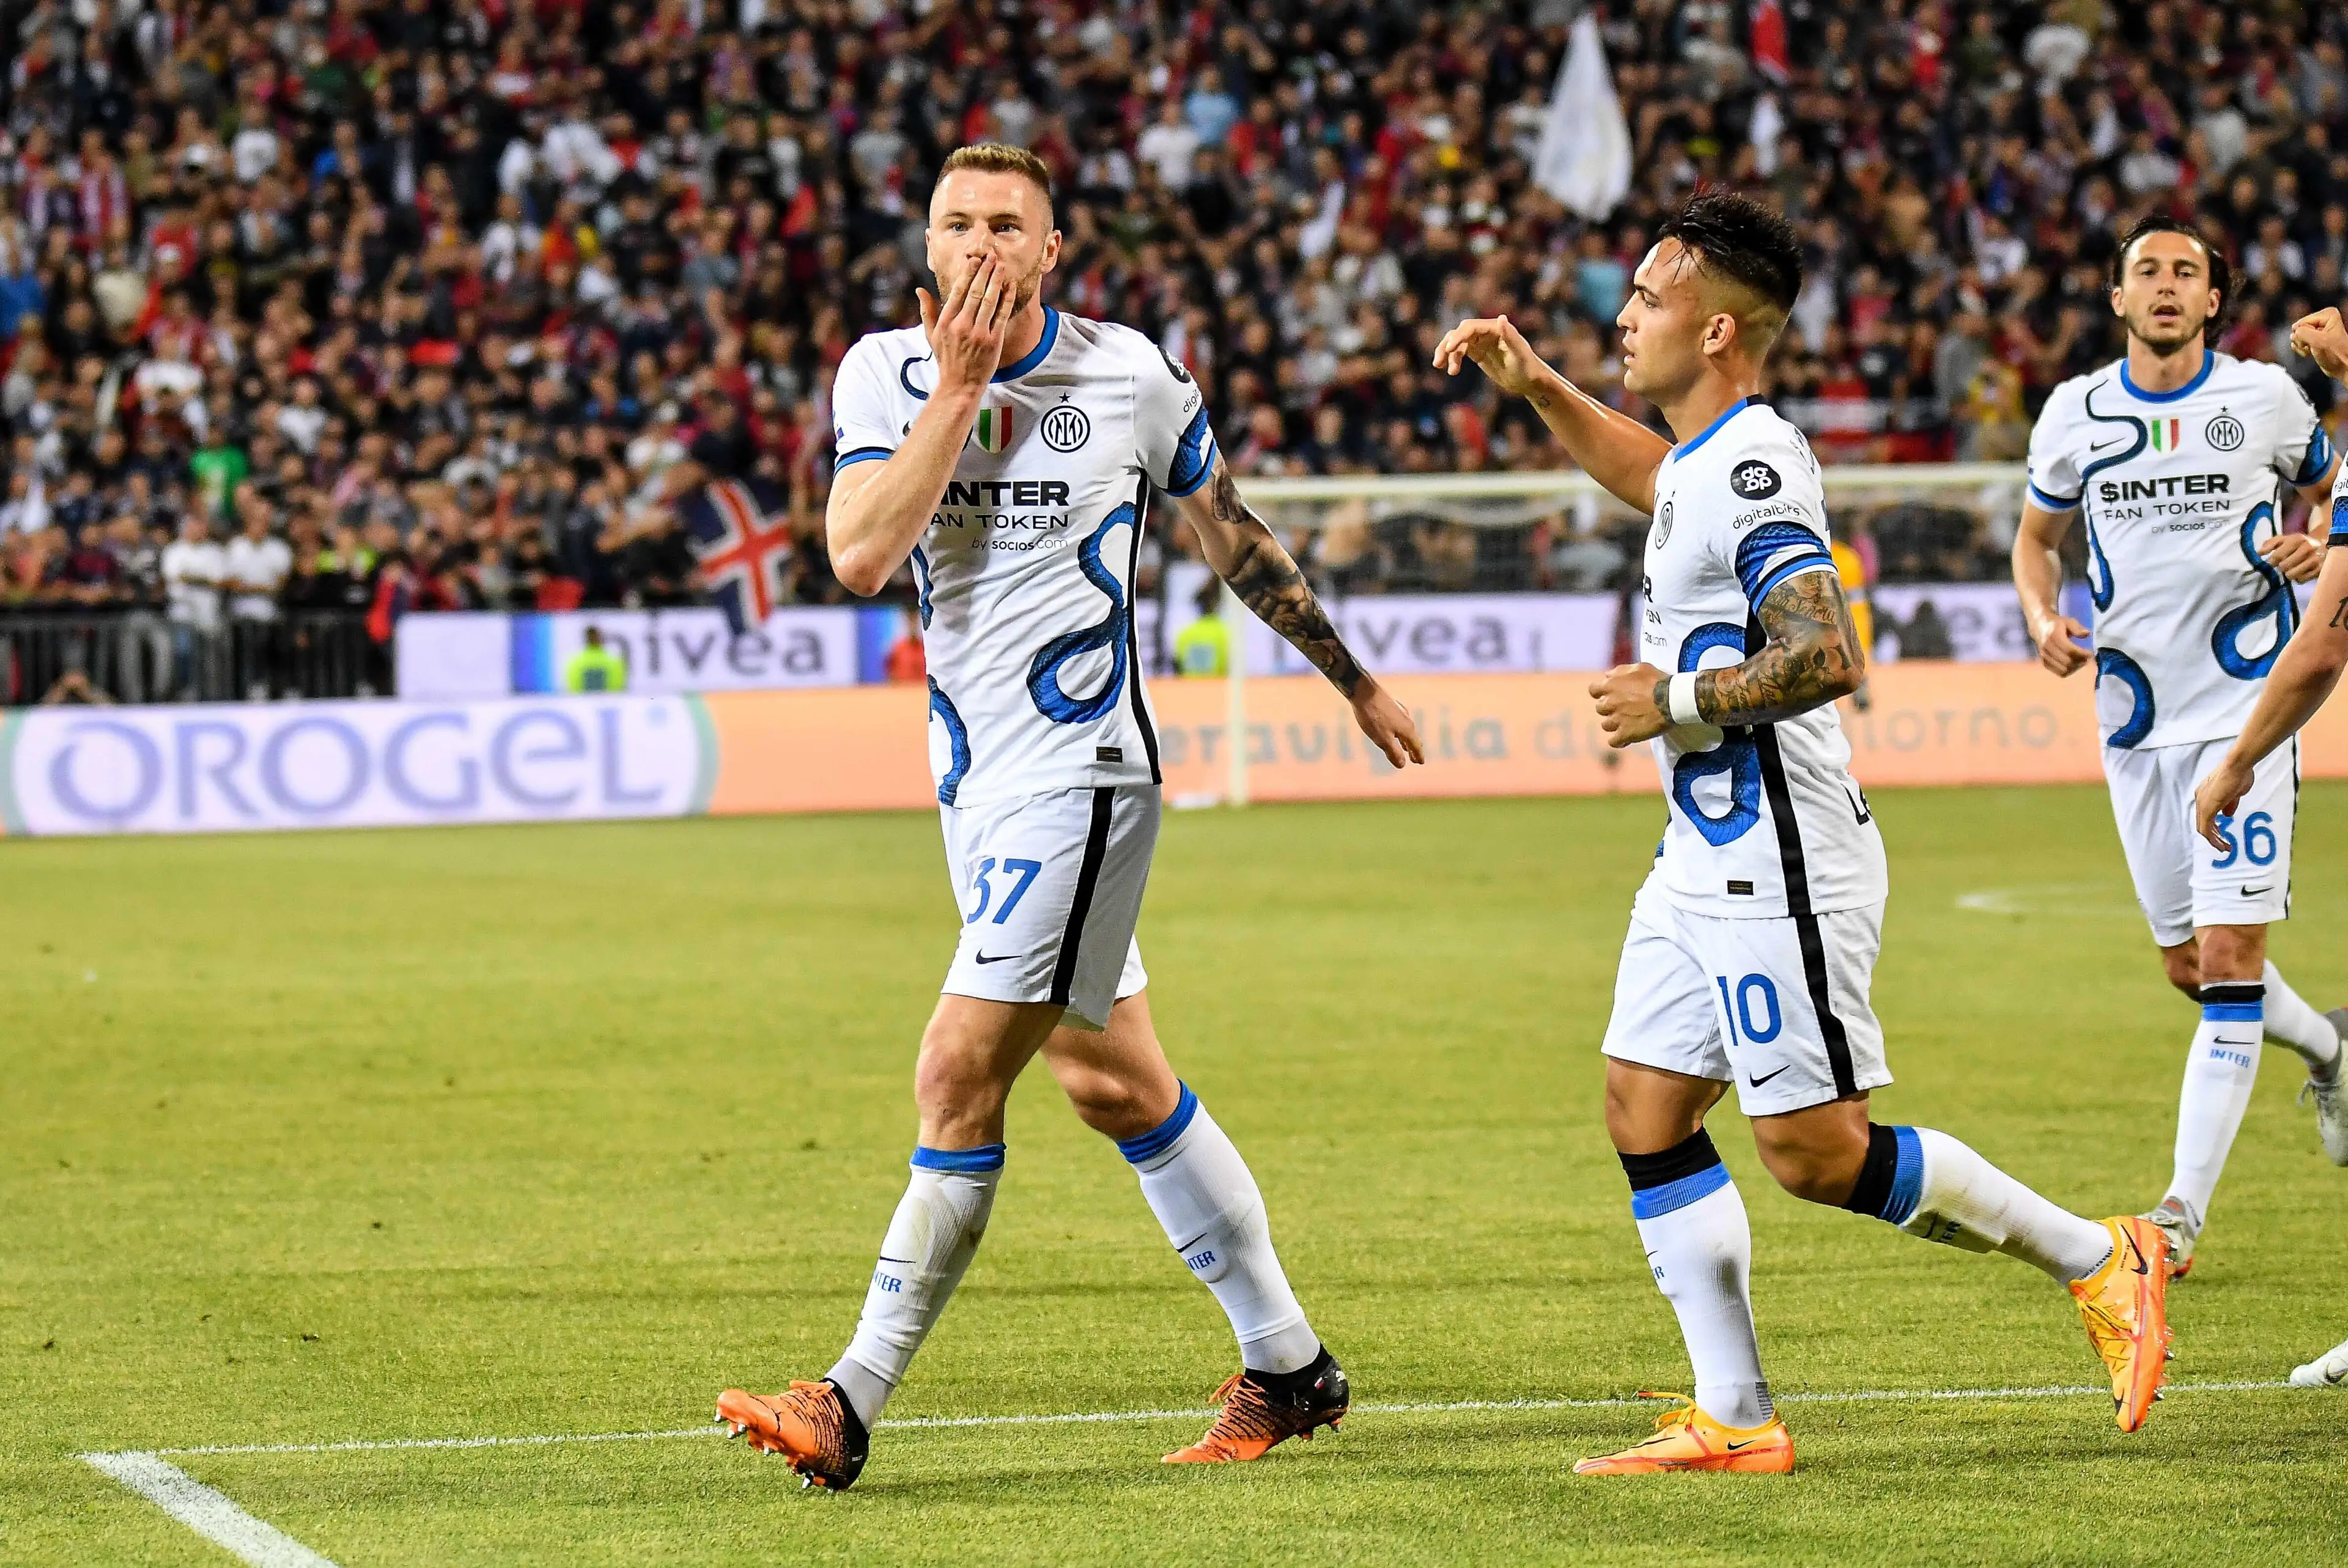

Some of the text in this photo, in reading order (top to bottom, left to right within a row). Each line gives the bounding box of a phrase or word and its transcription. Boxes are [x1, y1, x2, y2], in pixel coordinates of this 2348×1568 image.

[2100, 474, 2230, 506] $INTER
[930, 513, 1069, 529] AN TOKEN
[1733, 504, 1800, 529] digitalbits
[2104, 500, 2231, 520] FAN TOKEN
[972, 536, 988, 551] by
[2212, 811, 2277, 870] 36
[967, 857, 1043, 925] 37
[1716, 973, 1782, 1047] 10
[2210, 1049, 2250, 1068] INTER
